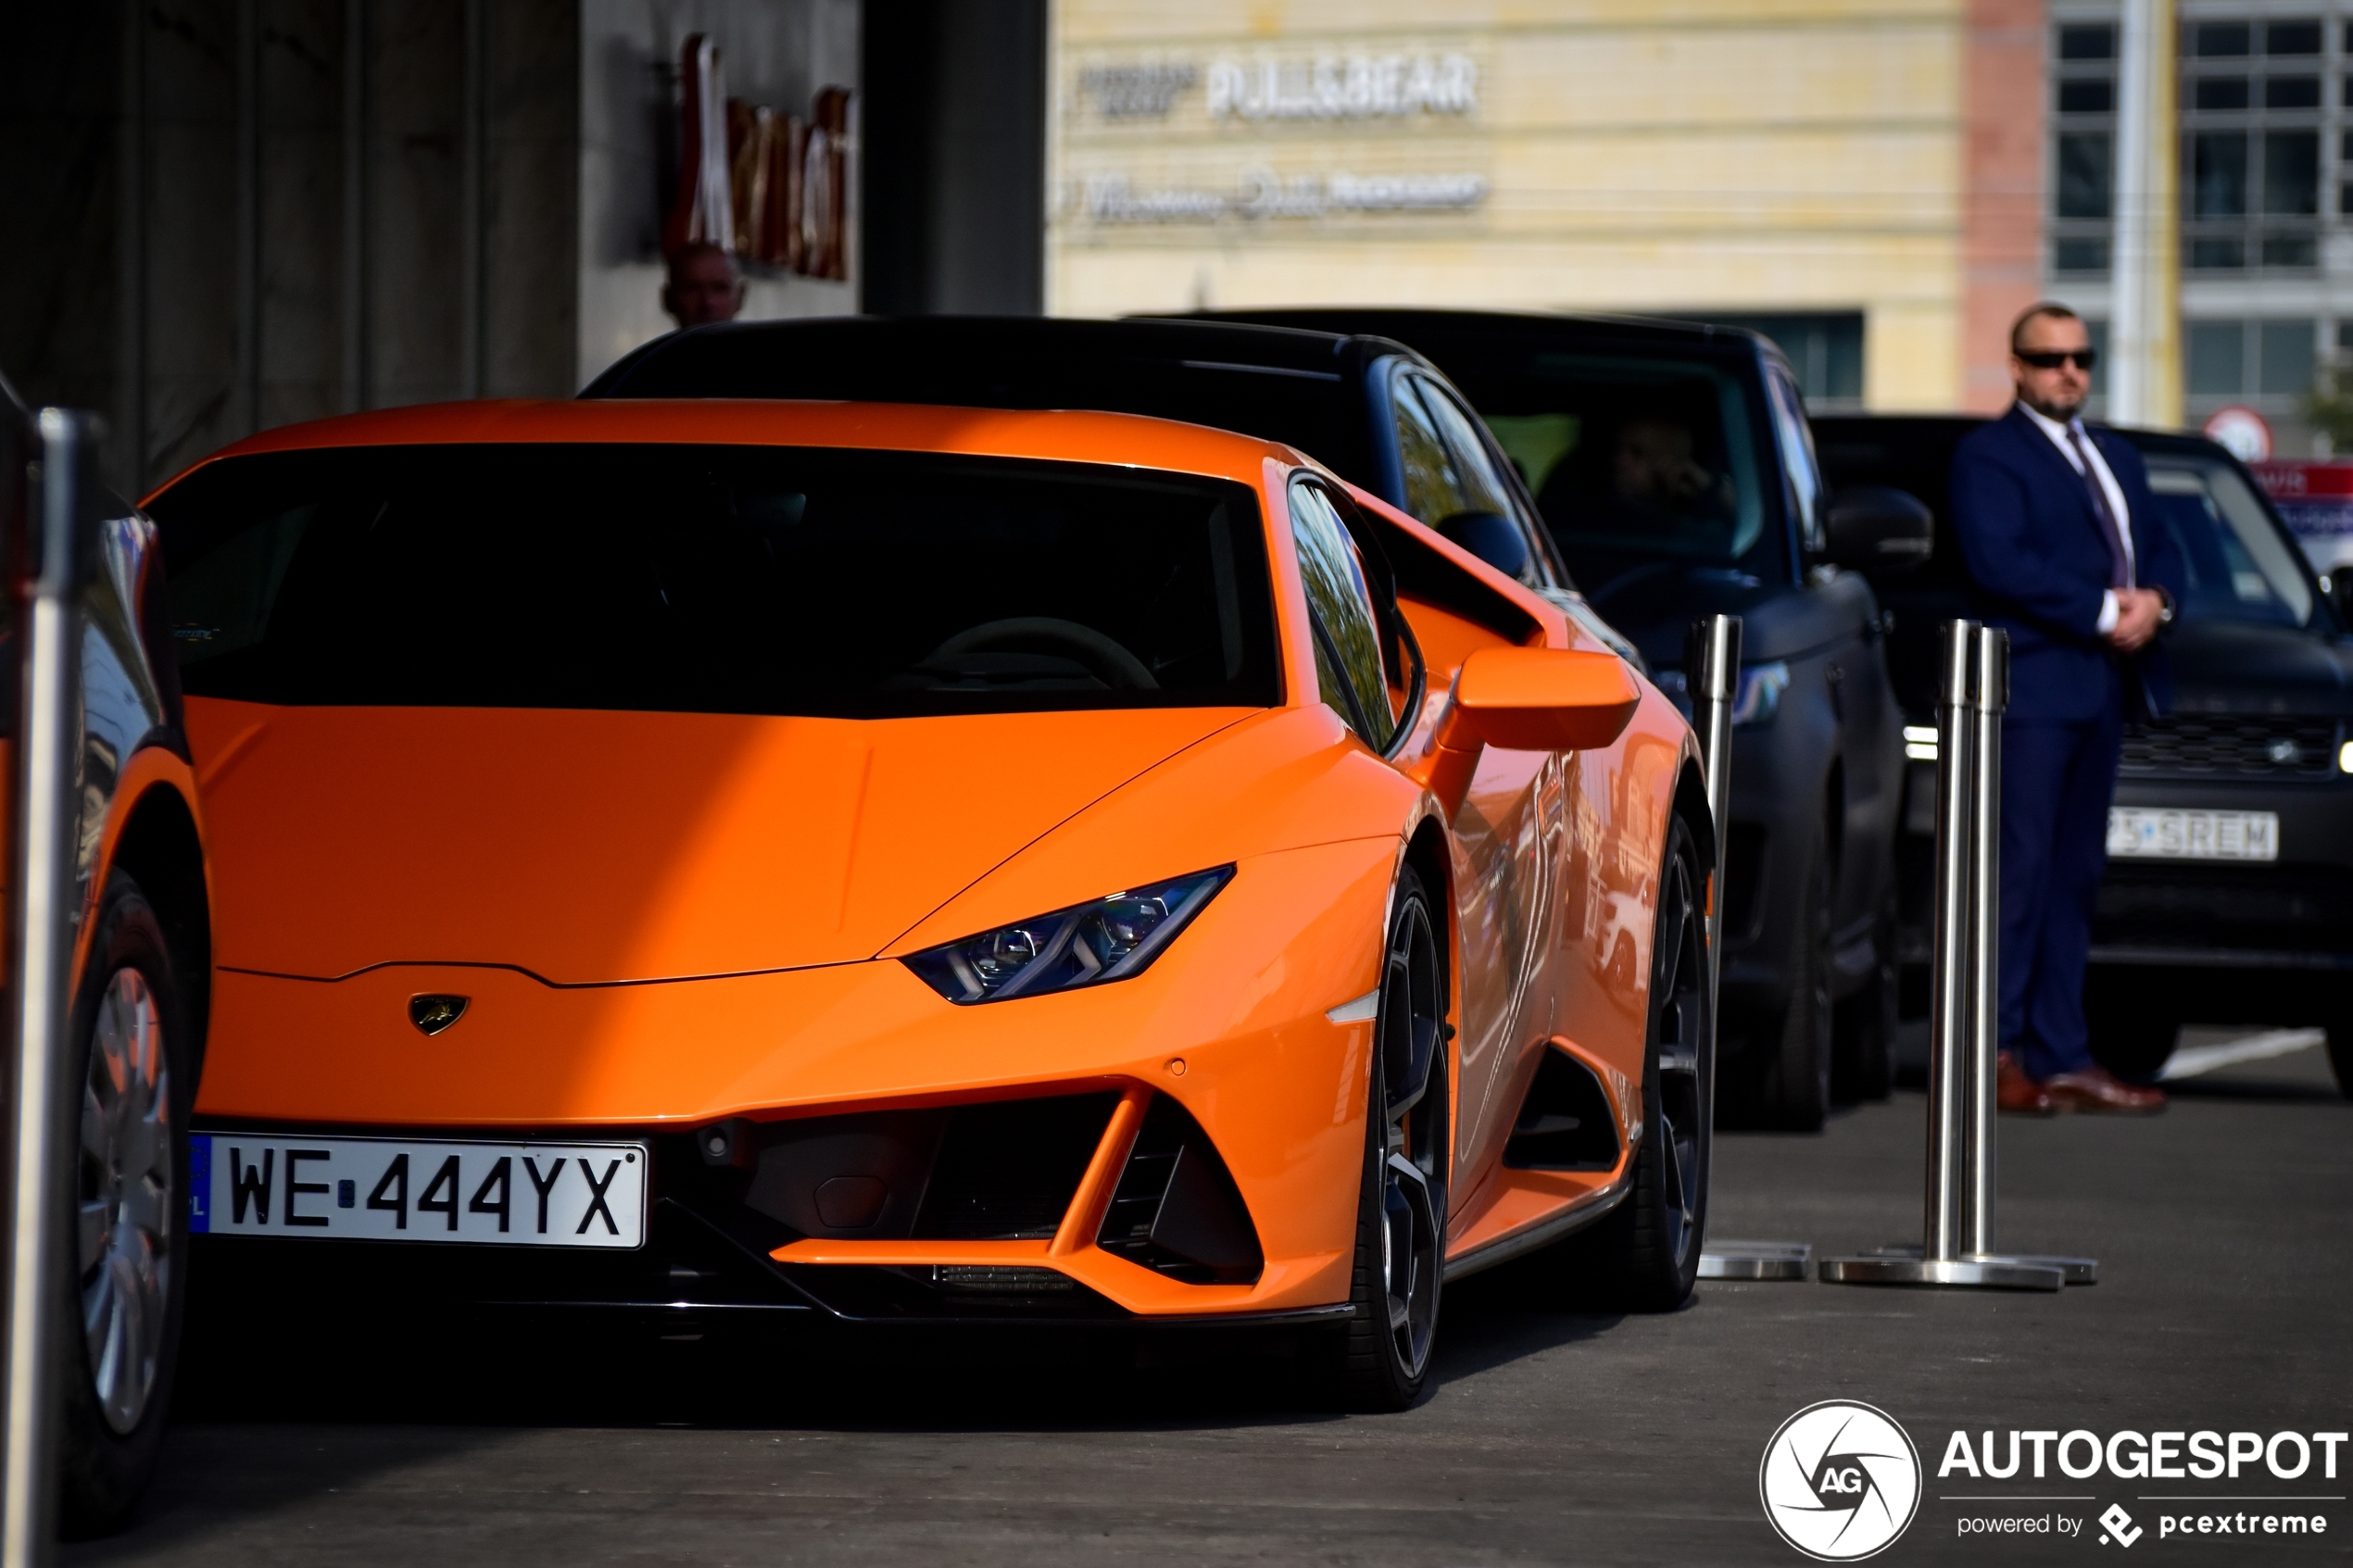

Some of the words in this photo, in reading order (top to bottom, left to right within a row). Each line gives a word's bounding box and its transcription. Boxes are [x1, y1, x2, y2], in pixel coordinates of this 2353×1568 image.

[2159, 810, 2269, 859] SREM
[230, 1147, 332, 1227] WE
[366, 1152, 623, 1236] 444YX
